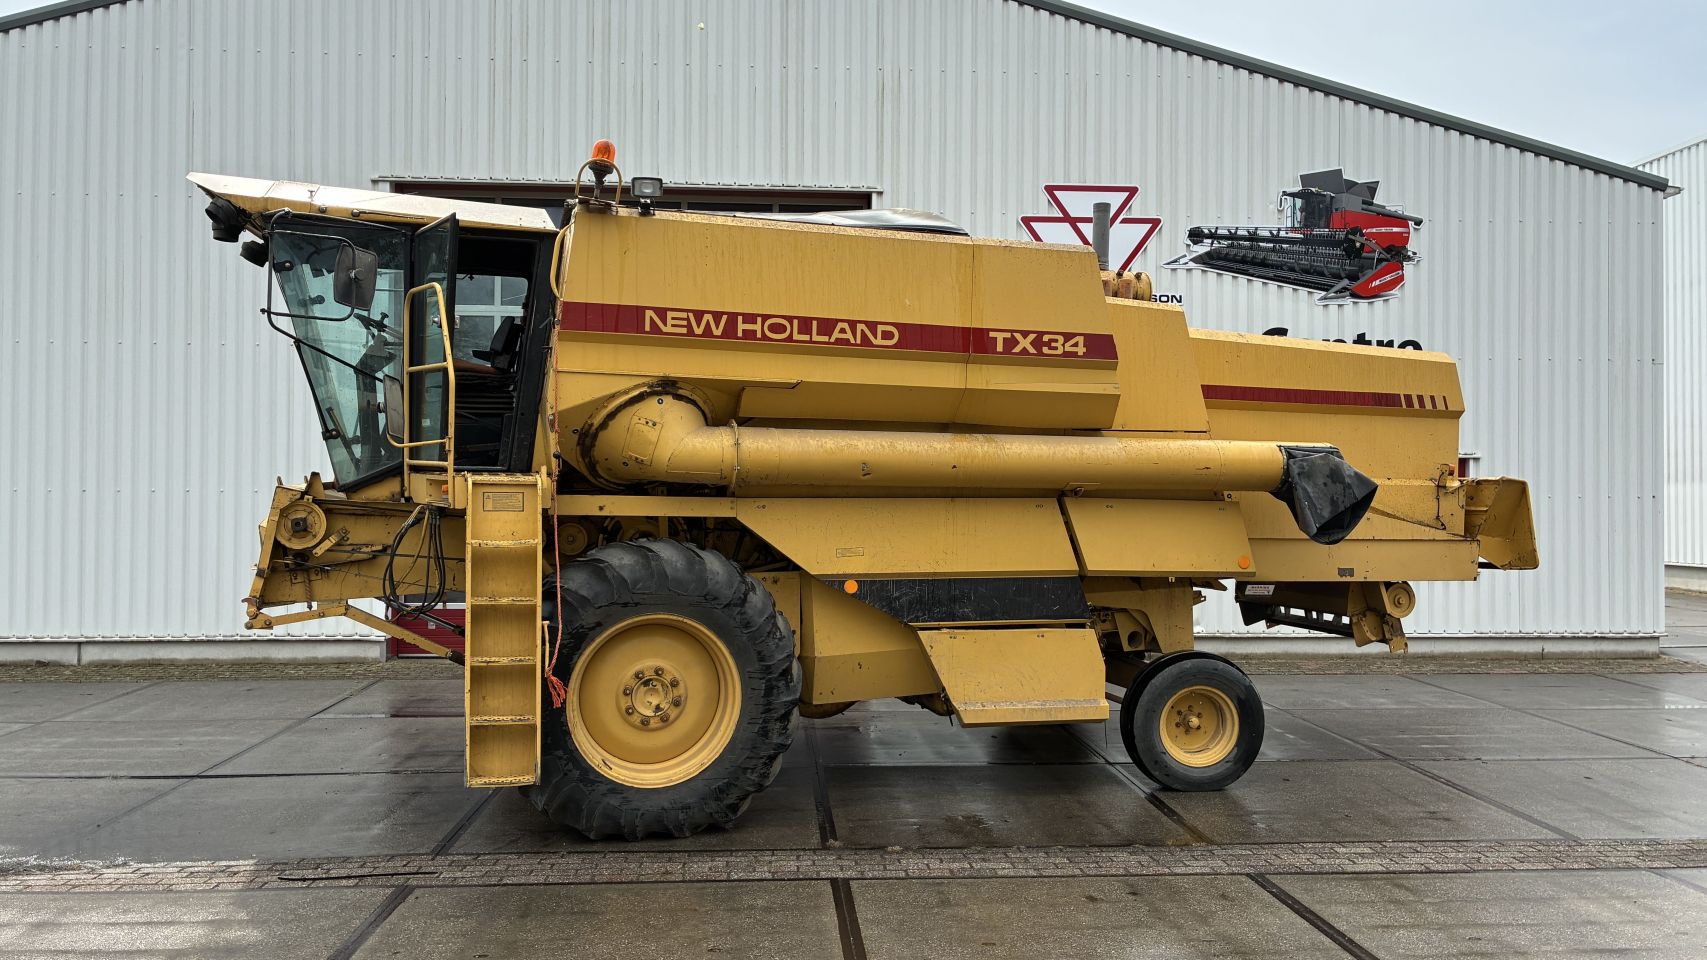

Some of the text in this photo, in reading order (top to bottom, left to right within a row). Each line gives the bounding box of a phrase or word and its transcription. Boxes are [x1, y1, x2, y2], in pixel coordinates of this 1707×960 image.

[644, 309, 900, 346] NEW HOLLAND
[988, 331, 1087, 356] TX 34
